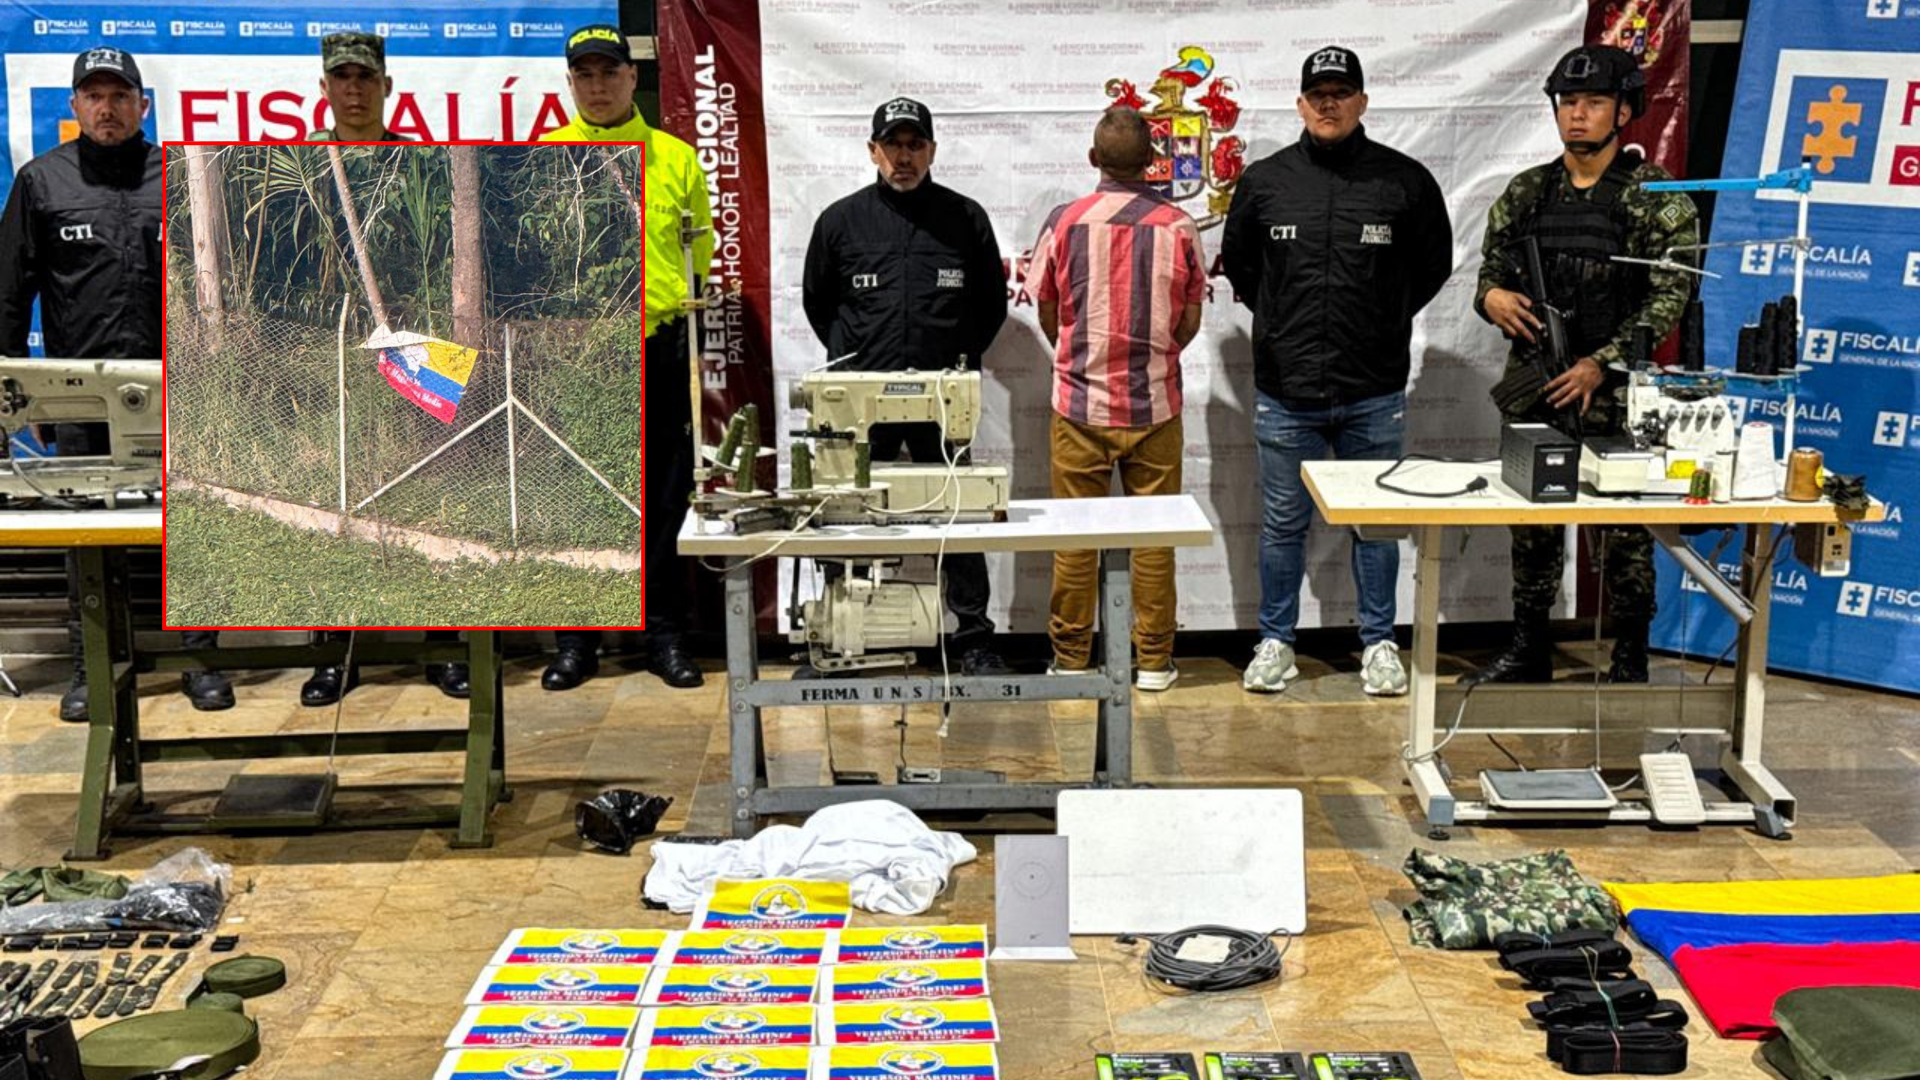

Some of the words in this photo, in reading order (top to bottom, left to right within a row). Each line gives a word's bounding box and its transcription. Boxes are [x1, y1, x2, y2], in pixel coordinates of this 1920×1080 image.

[570, 28, 620, 48] POLICÍA
[87, 49, 123, 63] CTI
[1313, 50, 1347, 64] CTI
[886, 100, 919, 115] CTI
[719, 83, 739, 179] LEALTAD
[60, 224, 93, 241] CTI
[721, 192, 741, 276] HONOR
[1270, 225, 1297, 240] CTI
[852, 274, 878, 289] CTI
[726, 290, 745, 364] PATRIA
[801, 688, 859, 701] FERMA
[1002, 684, 1021, 696] 31
